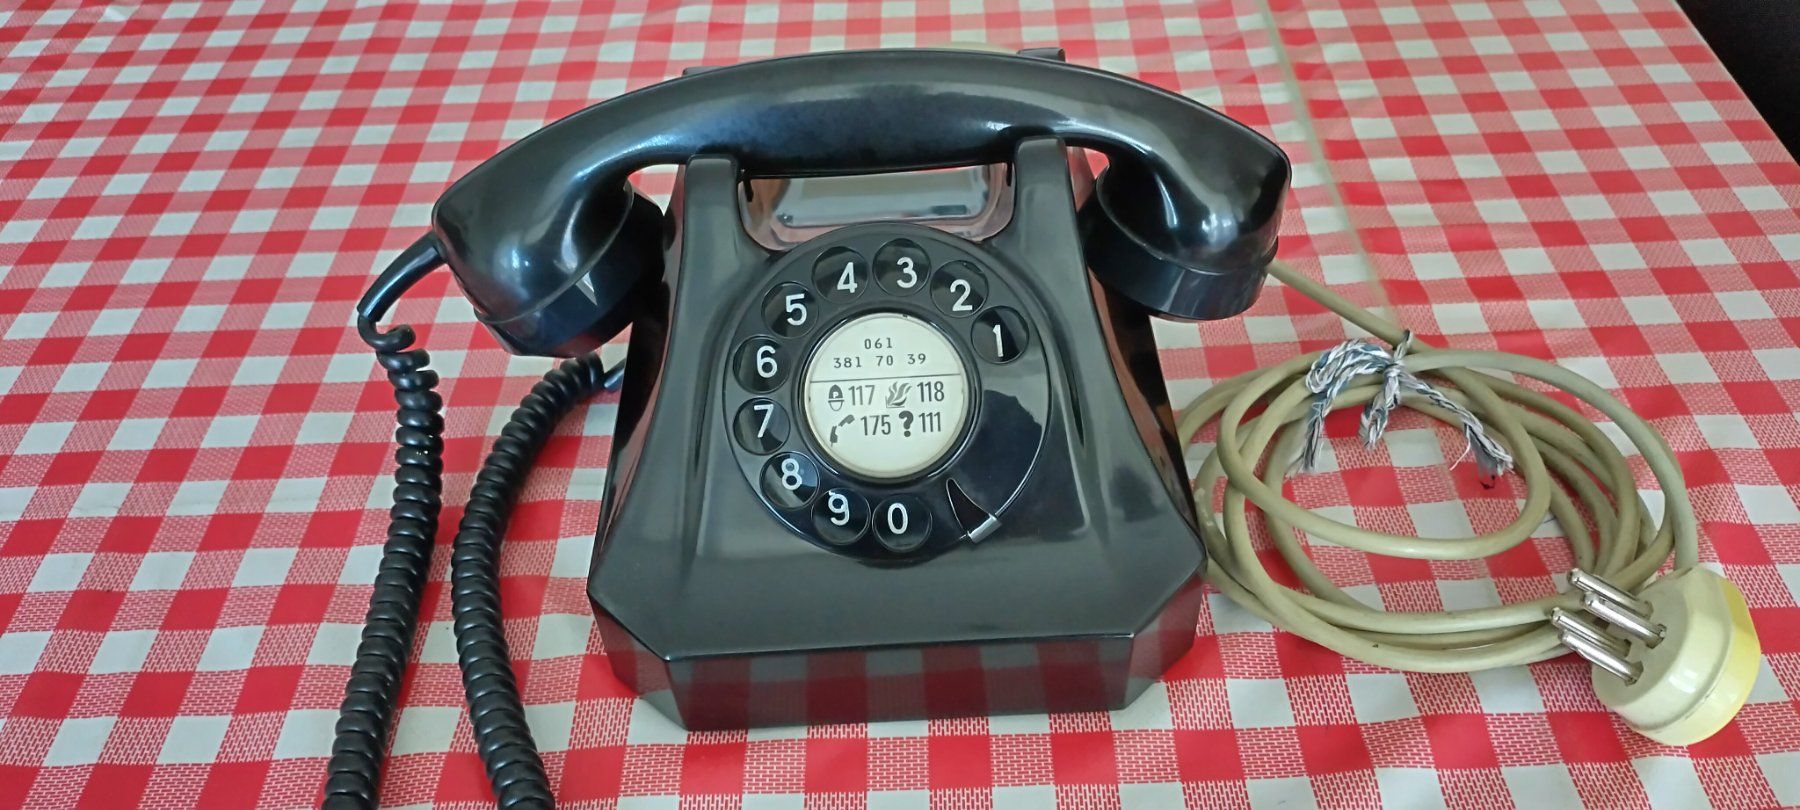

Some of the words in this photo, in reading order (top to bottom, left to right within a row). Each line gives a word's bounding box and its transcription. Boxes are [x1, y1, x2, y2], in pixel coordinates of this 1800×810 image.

[837, 262, 858, 293] 4
[896, 257, 918, 288] 3
[785, 293, 807, 326] 5
[950, 279, 973, 311] 2
[864, 337, 893, 350] 061
[992, 324, 1004, 357] 1
[756, 345, 778, 378] 6
[833, 357, 862, 369] 381
[876, 355, 894, 366] 70
[907, 353, 927, 365] 39
[848, 384, 876, 406] 117
[917, 381, 945, 402] 118
[753, 404, 774, 438] 7
[860, 415, 892, 436] 175
[898, 410, 914, 437] ?
[919, 412, 942, 433] 111
[781, 458, 803, 490] 8
[828, 490, 850, 526] 9
[887, 502, 908, 534] 0
